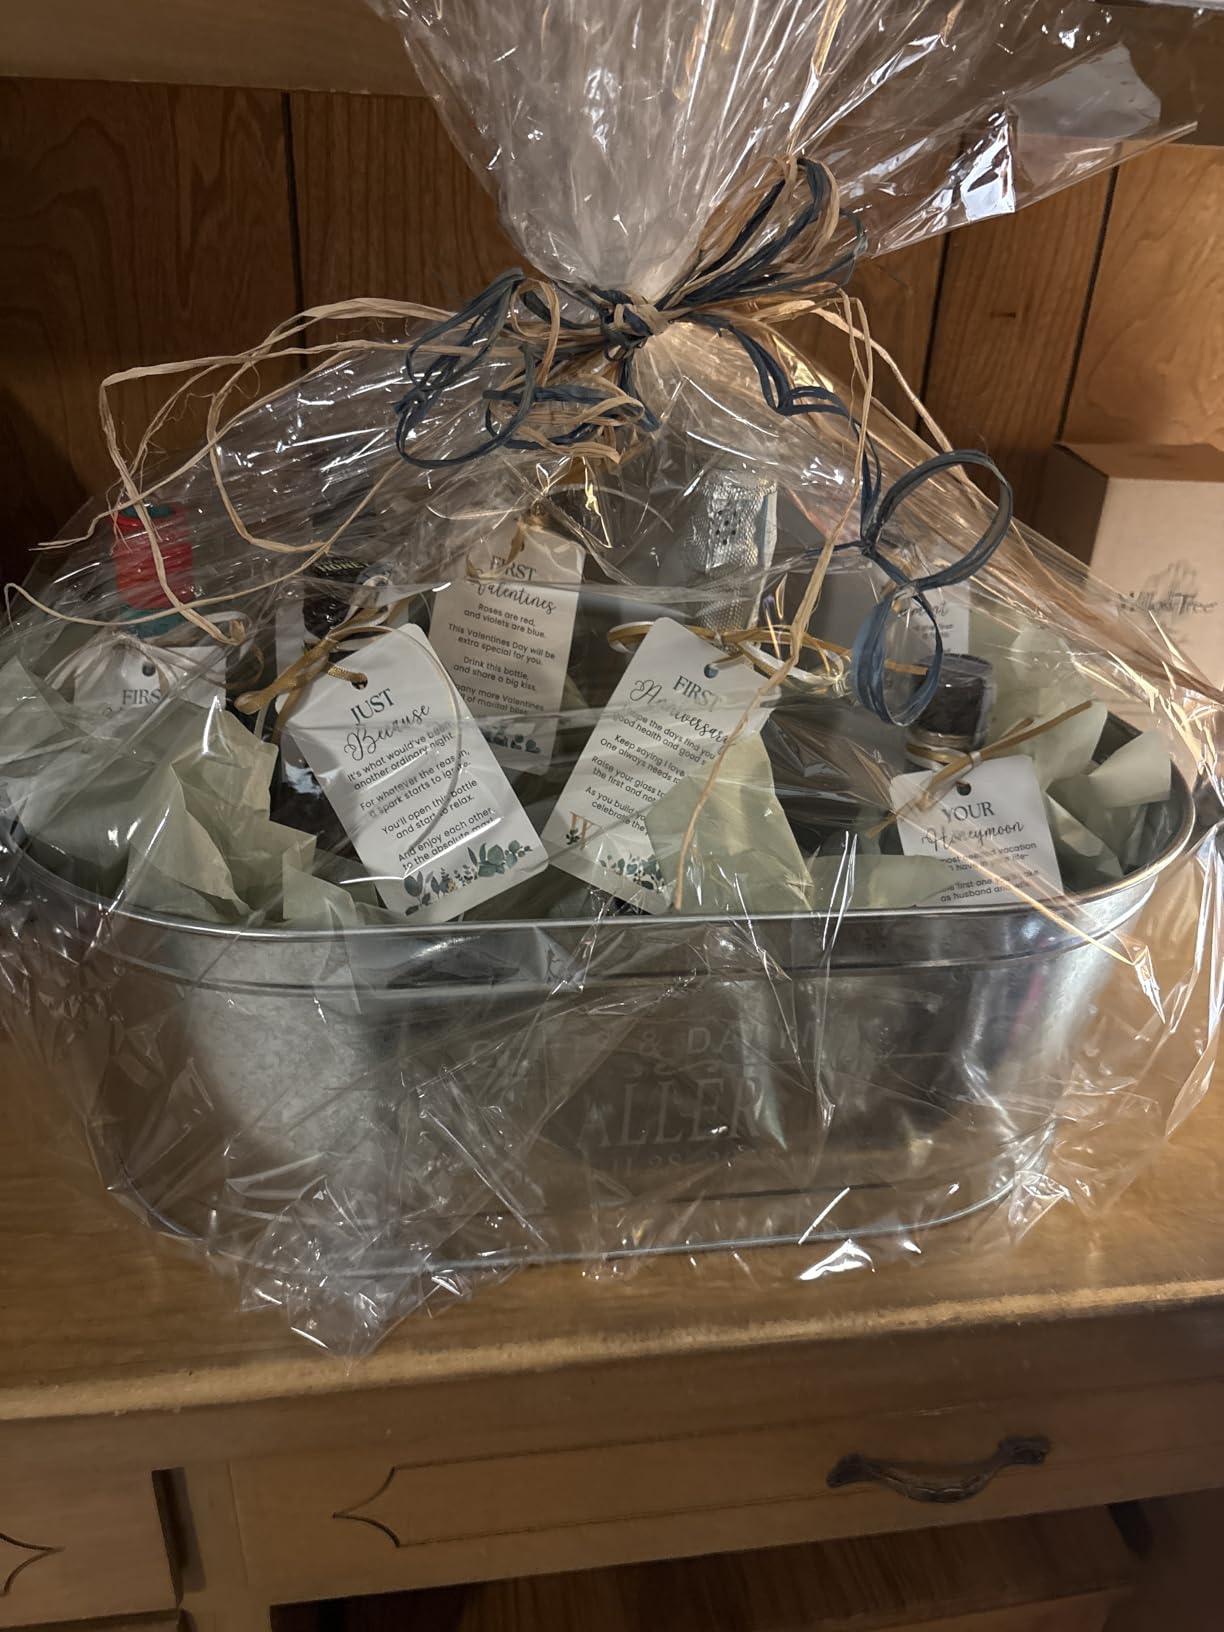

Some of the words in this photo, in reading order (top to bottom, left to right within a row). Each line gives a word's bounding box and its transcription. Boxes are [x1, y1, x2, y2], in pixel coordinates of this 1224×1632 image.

[463, 609, 481, 620] and
[482, 613, 510, 629] violets
[511, 622, 526, 632] are
[478, 603, 502, 617] Roses
[504, 610, 519, 621] are
[448, 623, 465, 635] This
[467, 628, 511, 649] Valentines
[512, 641, 529, 654] Day
[529, 646, 544, 656] will
[544, 650, 556, 660] be
[457, 636, 480, 648] extra
[481, 642, 512, 658] special
[513, 650, 526, 661] for
[453, 663, 471, 675] and
[472, 668, 496, 681] share
[497, 675, 504, 683] a
[505, 677, 520, 690] big
[463, 655, 485, 668] Drink
[486, 662, 503, 673] this
[503, 667, 529, 681] bottle,
[122, 688, 163, 705] FIRS
[350, 687, 396, 726] JUST
[466, 696, 477, 704] of
[478, 689, 501, 701] more
[502, 694, 545, 712] Valentines
[672, 674, 723, 713] FIRST
[629, 679, 731, 746] Aiversar
[343, 704, 430, 761] Because
[635, 723, 662, 742] health
[662, 738, 680, 751] and
[679, 747, 702, 763] good
[649, 719, 663, 731] the
[663, 727, 684, 744] days
[683, 737, 701, 752] find
[700, 748, 716, 760] you
[347, 770, 362, 783] It's
[362, 757, 387, 774] what
[386, 735, 426, 761] would've
[354, 766, 389, 791] another
[390, 745, 429, 771] ordinary
[600, 737, 617, 751] One
[618, 749, 646, 768] always
[647, 763, 672, 781] needs
[614, 734, 636, 751] Keep
[636, 745, 664, 767] saying
[667, 761, 685, 777] love
[360, 799, 375, 810] For
[375, 776, 418, 802] whatever
[419, 766, 435, 780] the
[591, 755, 614, 773] Raise
[614, 768, 634, 783] your
[634, 779, 657, 795] glass
[592, 767, 607, 780] the
[607, 775, 625, 789] first
[624, 785, 642, 797] and
[377, 793, 403, 815] spark
[404, 780, 431, 800] starts
[431, 773, 442, 785] to
[382, 816, 408, 835] You'll
[408, 804, 432, 822] open
[432, 795, 450, 808] thi
[450, 780, 478, 798] bottle
[585, 785, 598, 797] As
[596, 792, 613, 805] you
[614, 800, 635, 814] build
[941, 801, 995, 823] YOUR
[396, 825, 415, 839] and
[591, 801, 631, 826] celebrate
[631, 820, 646, 832] the
[398, 846, 416, 862] And
[417, 833, 442, 853] enjoy
[443, 820, 467, 837] each
[402, 861, 412, 871] to
[414, 850, 430, 866] the
[431, 830, 470, 857] absolute
[921, 819, 1025, 852] Honeymoon
[998, 842, 1037, 855] vacation
[953, 887, 992, 900] husband
